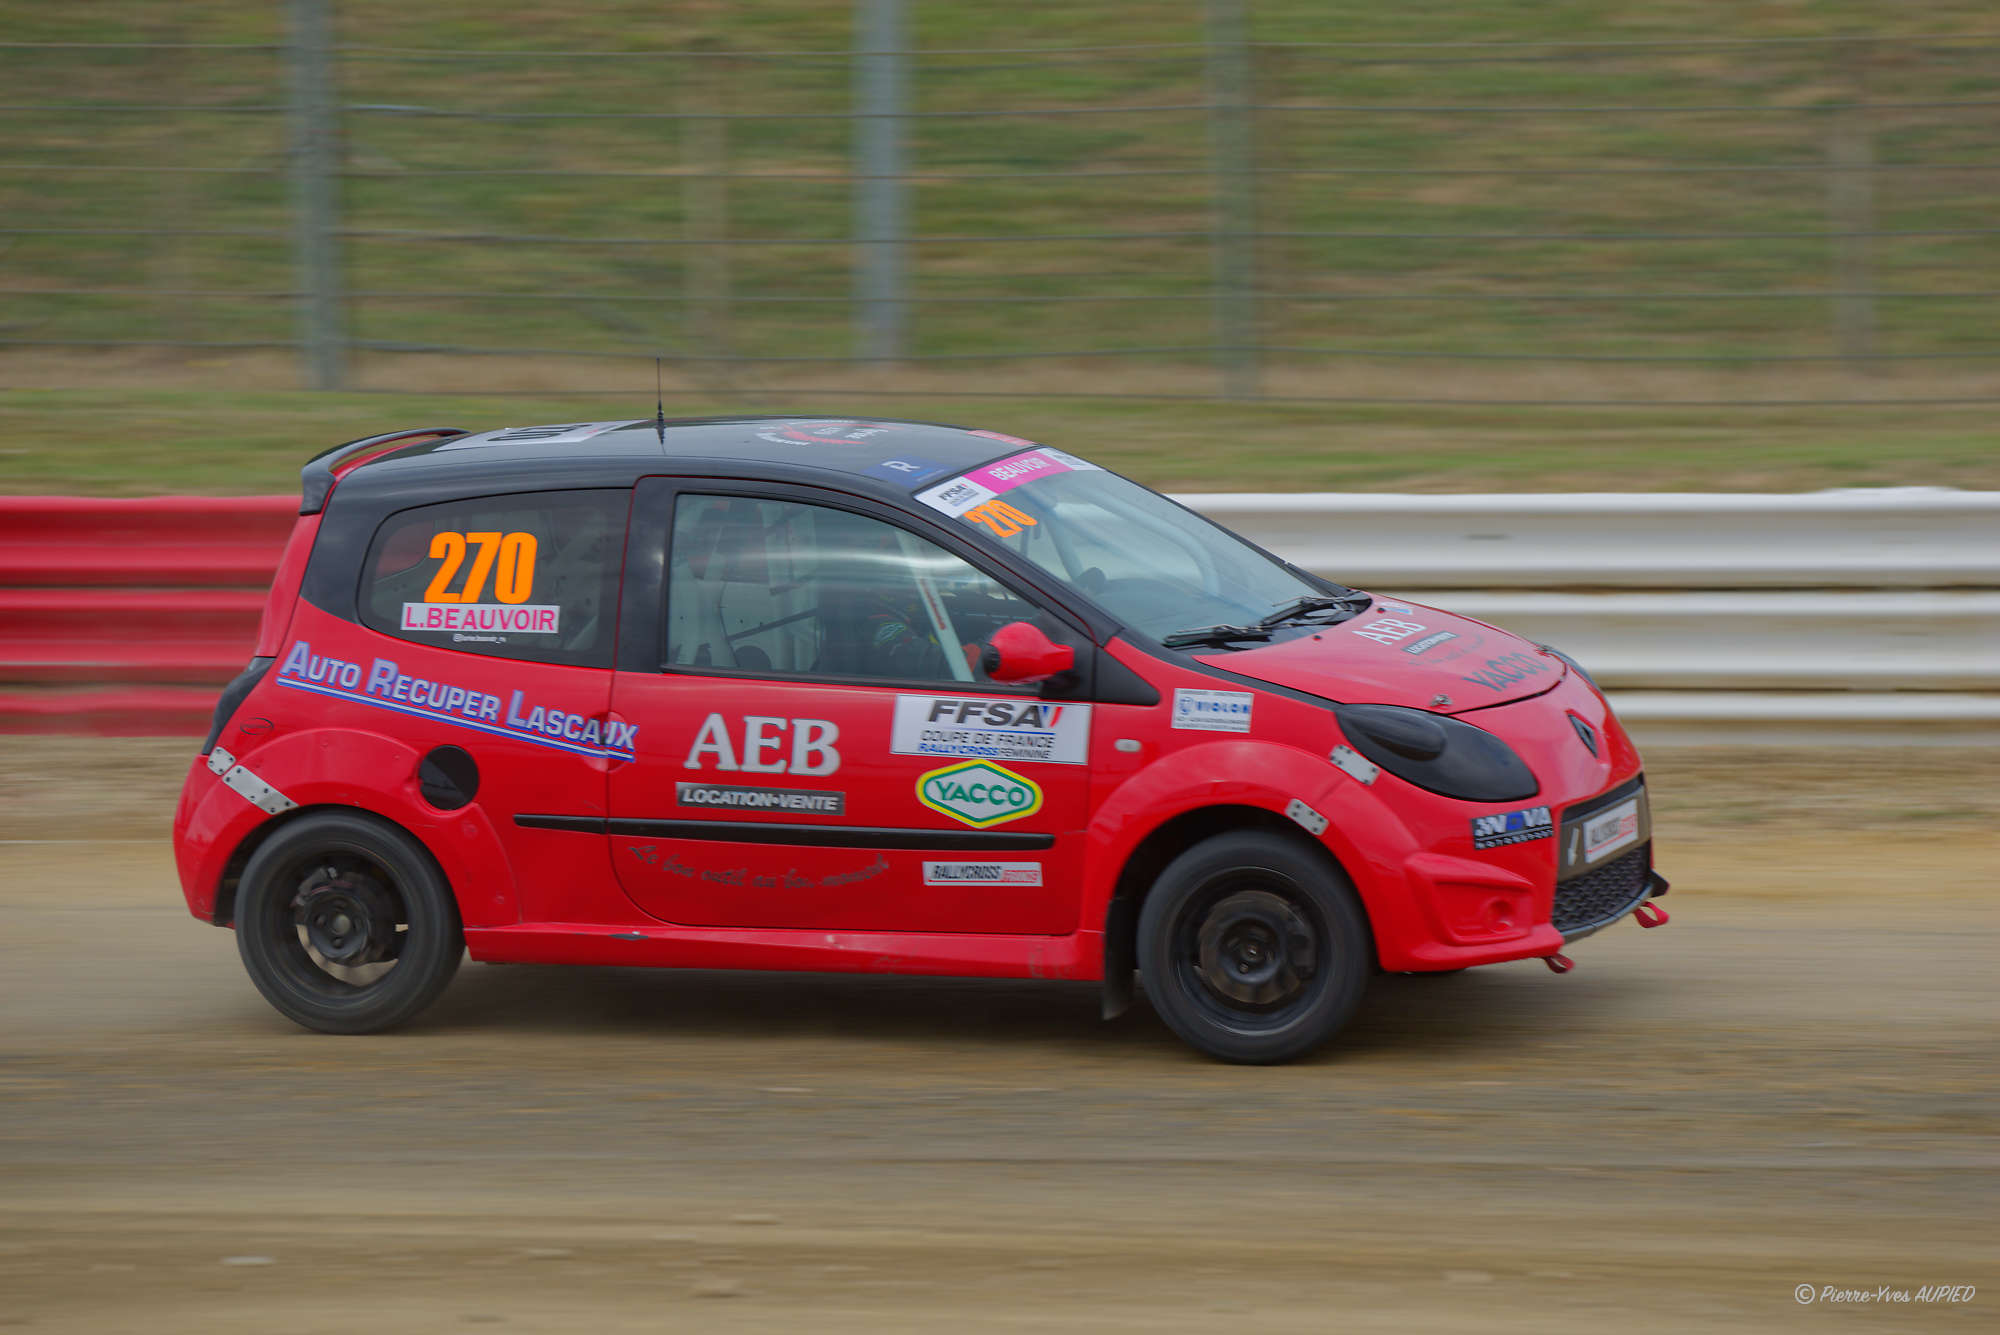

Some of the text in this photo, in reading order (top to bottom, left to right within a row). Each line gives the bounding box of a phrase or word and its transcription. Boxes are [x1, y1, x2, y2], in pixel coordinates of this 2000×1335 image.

[988, 457, 1051, 480] BEAUVOIR
[963, 499, 1038, 538] 270
[424, 531, 538, 605] 270
[405, 606, 556, 631] L.BEAUVOIR
[1352, 618, 1428, 645] AEB
[1461, 652, 1550, 692] YACCO
[928, 699, 1044, 729] FFSA
[683, 712, 841, 777] AEB
[921, 730, 1056, 748] COUPE DE FRANCE
[935, 780, 1025, 806] YACCO
